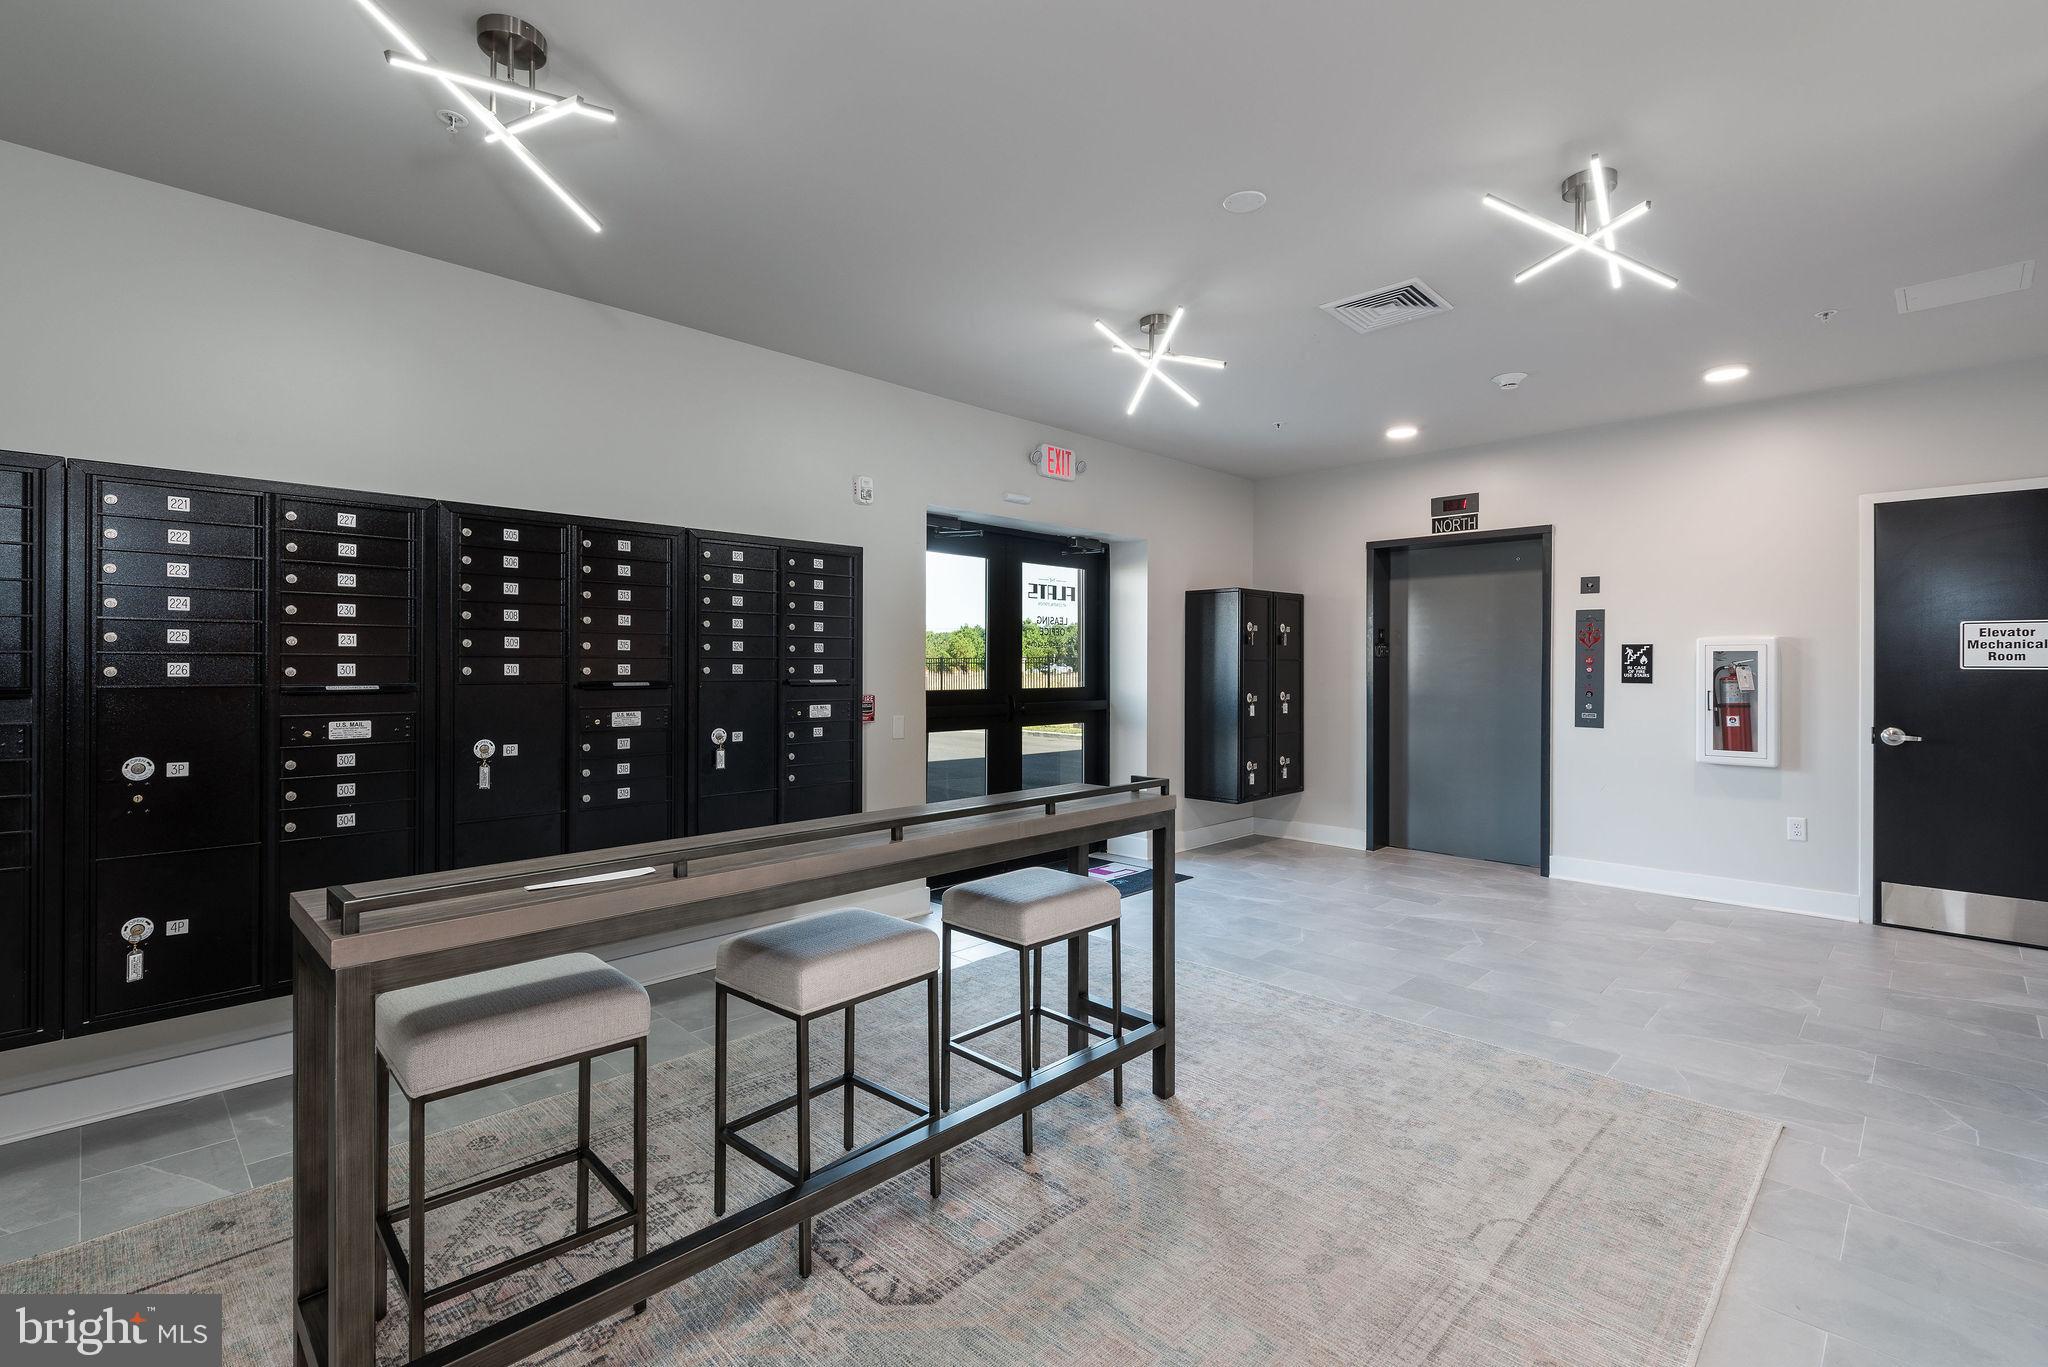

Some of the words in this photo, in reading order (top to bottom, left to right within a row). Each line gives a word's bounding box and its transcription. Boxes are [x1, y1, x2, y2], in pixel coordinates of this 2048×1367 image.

[1047, 446, 1072, 476] EXIT
[170, 498, 188, 510] 221
[339, 515, 355, 525] 227
[1435, 516, 1476, 533] NORTH
[170, 531, 188, 543] 222
[504, 531, 517, 540] 305
[339, 545, 355, 555] 228
[619, 541, 629, 550] 311
[504, 557, 518, 567] 306
[169, 565, 188, 576] 223
[618, 566, 629, 575] 312
[339, 575, 355, 585] 229
[504, 584, 517, 593] 307
[618, 591, 630, 600] 313
[169, 598, 188, 609] 224
[338, 605, 355, 615] 230
[504, 611, 518, 620] 308
[619, 616, 630, 625] 314
[169, 631, 188, 642] 225
[1979, 628, 2036, 637] Elevator
[340, 635, 355, 645] 231
[505, 638, 519, 647] 309
[1967, 639, 2048, 649] Mechanical
[618, 641, 630, 650] 315
[1988, 651, 2026, 661] Room
[169, 665, 188, 675] 226
[339, 665, 355, 675] 301
[505, 665, 518, 674] 310
[618, 665, 630, 674] 316
[618, 739, 629, 748] 317
[505, 746, 515, 754] 6P
[338, 755, 354, 765] 302
[171, 764, 185, 775] 3P
[618, 765, 629, 773] 318
[338, 786, 354, 795] 303
[618, 789, 629, 798] 319
[338, 816, 354, 825] 304
[170, 921, 185, 933] 4P
